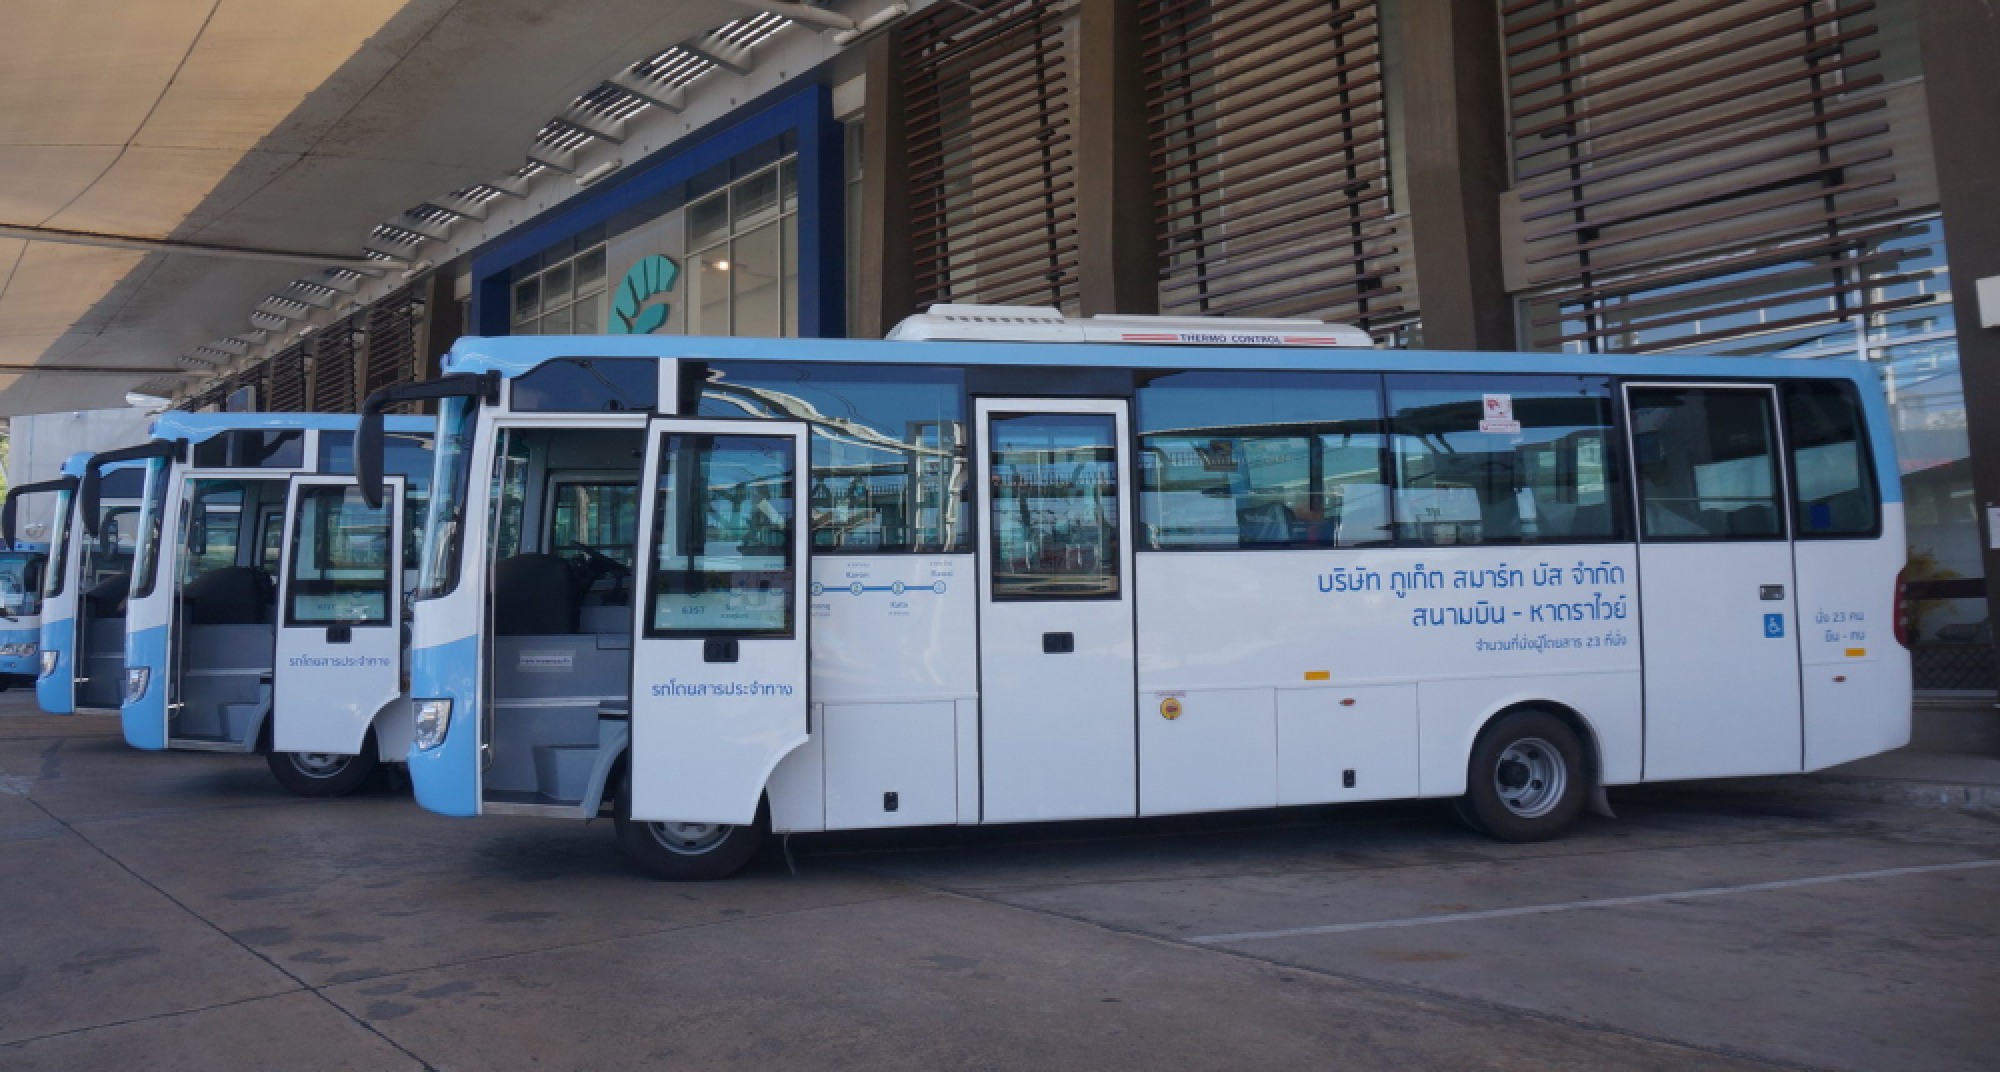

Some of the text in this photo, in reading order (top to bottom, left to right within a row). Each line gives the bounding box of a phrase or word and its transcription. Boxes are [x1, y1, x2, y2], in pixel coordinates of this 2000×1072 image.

[1180, 333, 1282, 344] THERMO CONTROL
[1318, 560, 1625, 598] บริษัท ภูเก็ต สมาร์ท บัส จำกัด
[1412, 600, 1505, 626] สนามบิน
[1530, 592, 1627, 622] หาดราไวย์
[1832, 611, 1846, 622] 23
[1587, 635, 1601, 648] 23
[290, 653, 390, 667] รถโดยสารประจำทาง
[651, 678, 793, 697] รถโดยสารประจำทาง
